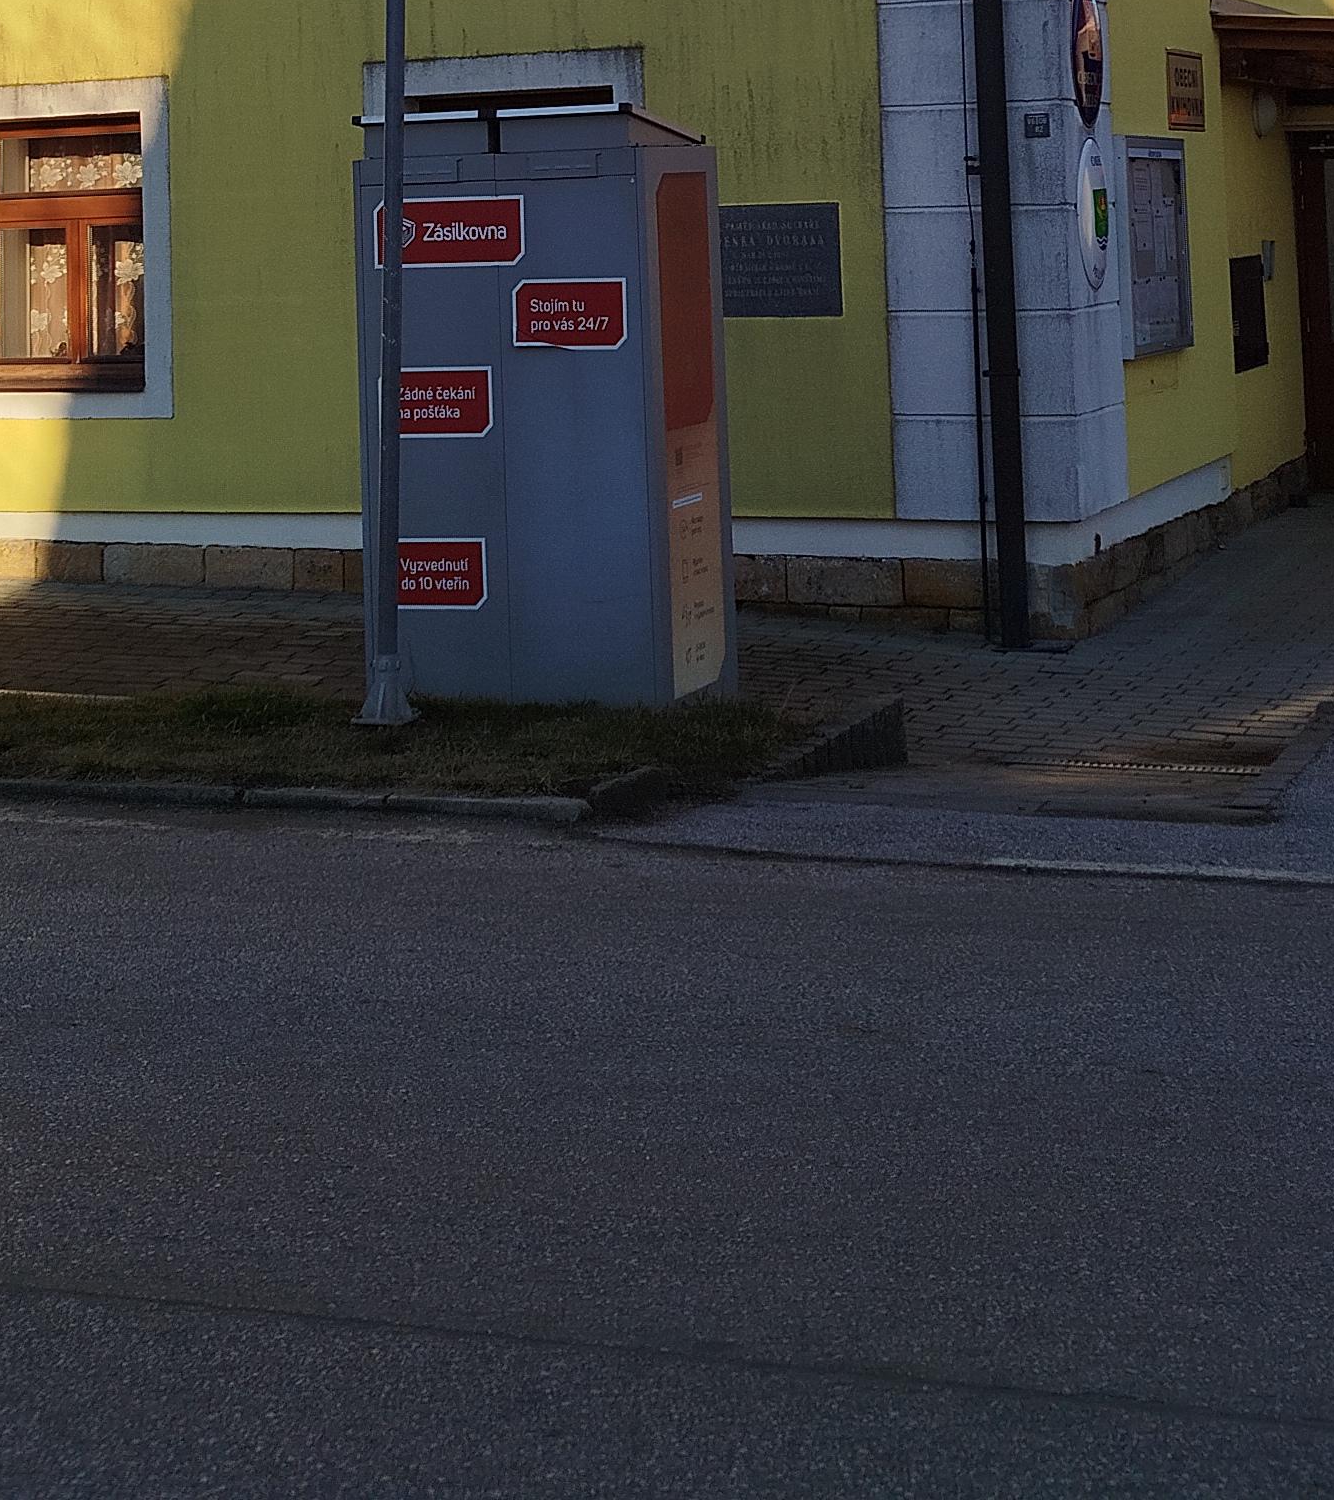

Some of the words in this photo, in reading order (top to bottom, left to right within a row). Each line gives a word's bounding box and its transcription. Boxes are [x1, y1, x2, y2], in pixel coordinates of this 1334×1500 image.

[422, 222, 507, 241] Zásilkovna
[530, 298, 569, 314] Stojím
[572, 299, 585, 312] tu
[530, 319, 552, 333] pro
[554, 317, 575, 331] vás
[577, 316, 609, 332] 24/7
[436, 386, 475, 400] čekání
[413, 405, 461, 421] pošťáka
[400, 557, 469, 574] Vyzvednutí
[401, 577, 416, 591] do
[418, 577, 433, 591] 10
[434, 576, 470, 591] vteřin
